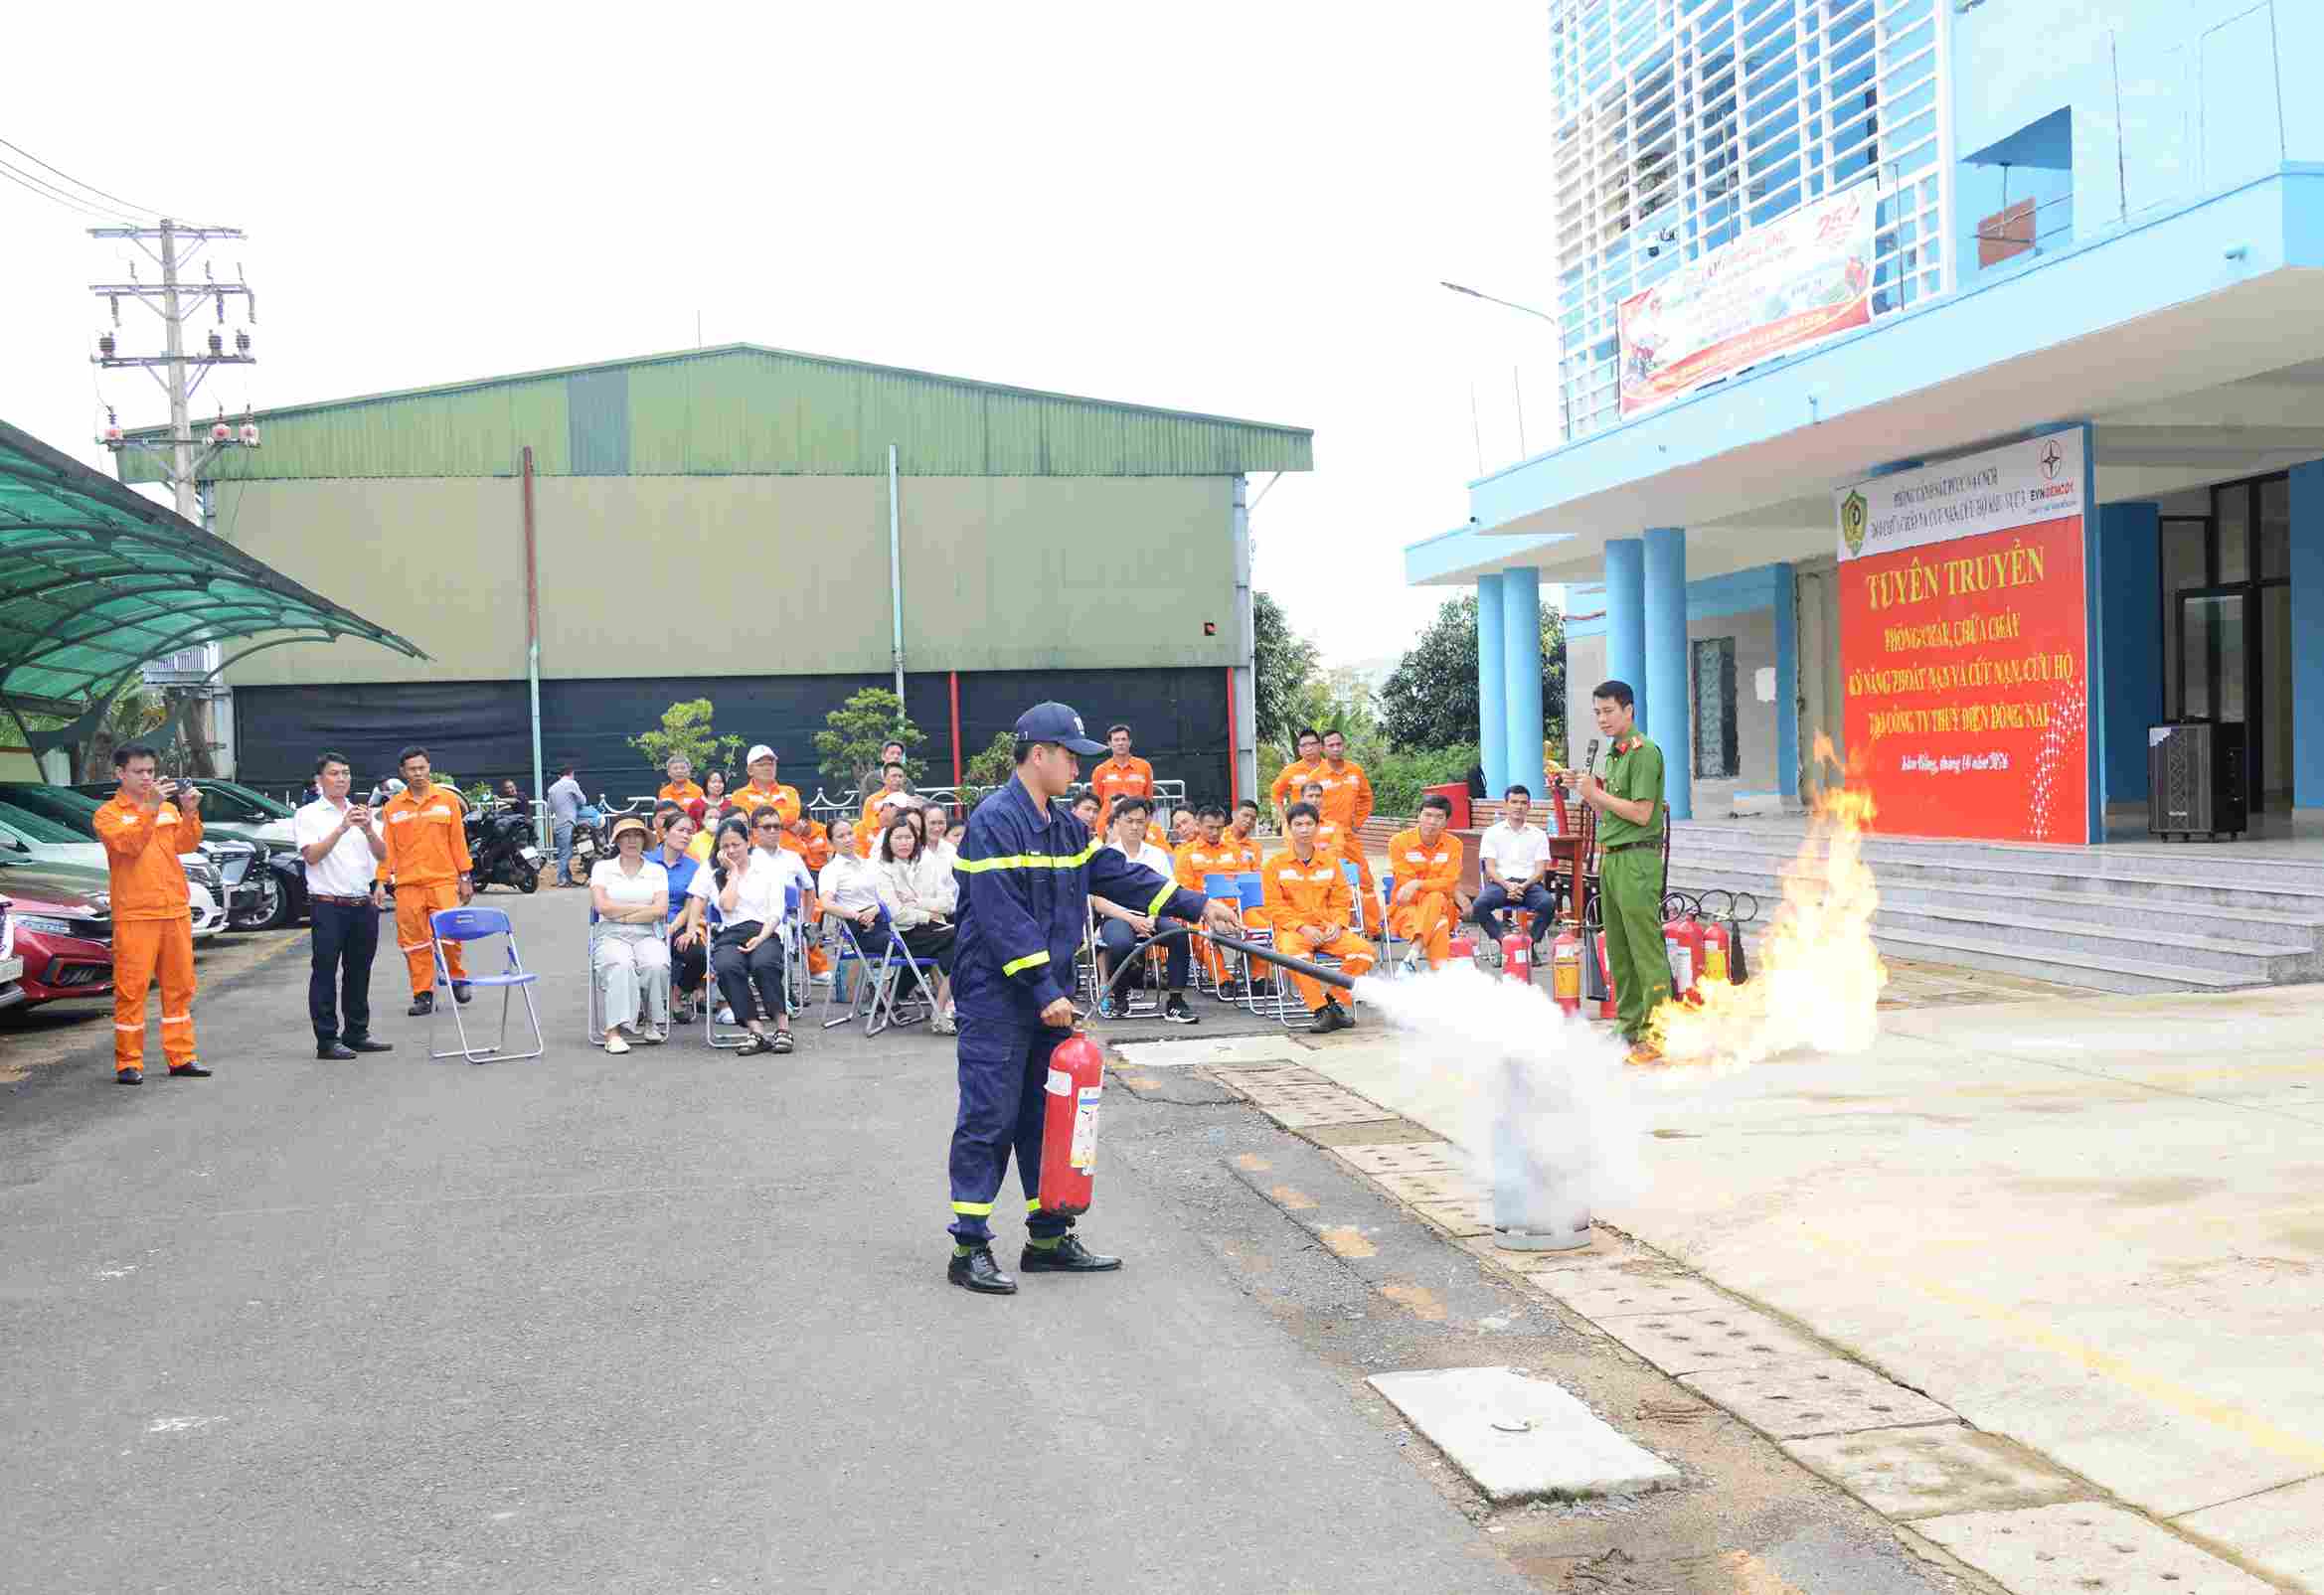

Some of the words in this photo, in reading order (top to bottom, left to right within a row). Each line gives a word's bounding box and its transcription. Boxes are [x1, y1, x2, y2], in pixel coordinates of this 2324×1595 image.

[1867, 557, 1938, 610] TUYÊN
[1943, 539, 2045, 596] TRUYỀN
[1914, 710, 1930, 732] TY
